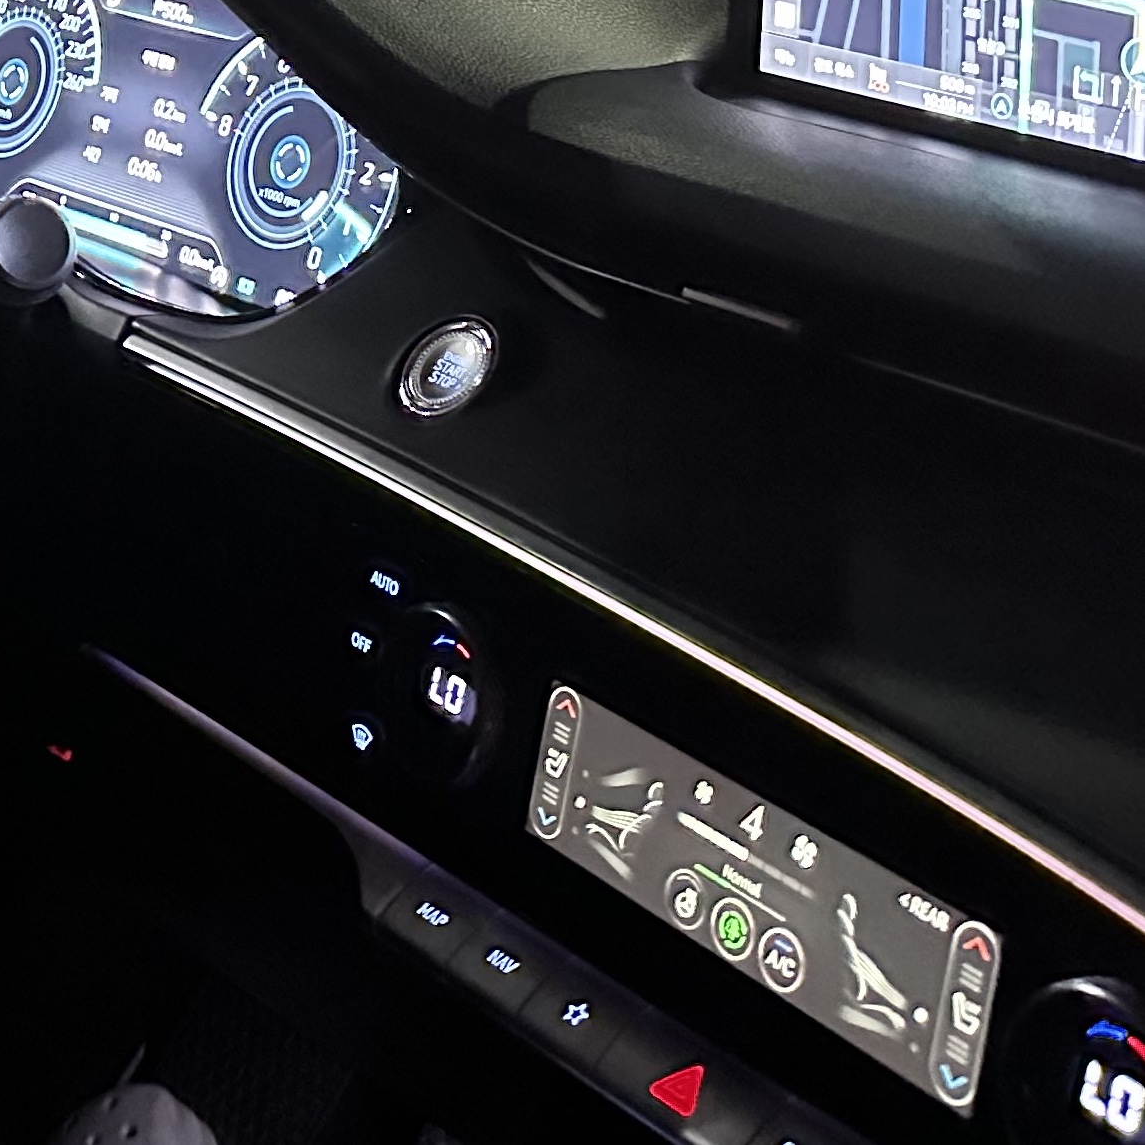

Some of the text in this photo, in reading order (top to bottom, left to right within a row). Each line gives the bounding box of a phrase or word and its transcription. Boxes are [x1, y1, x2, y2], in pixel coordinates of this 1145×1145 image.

[59, 13, 81, 32] 200
[65, 40, 88, 59] 230
[63, 73, 84, 92] 260
[245, 74, 259, 96] 7
[218, 113, 233, 136] 8
[358, 162, 377, 186] 2
[307, 246, 322, 270] 0
[370, 570, 400, 596] AUTO
[351, 631, 372, 653] OFF
[428, 666, 467, 716] LO
[738, 805, 765, 841] 4
[722, 863, 763, 899] Normal
[416, 902, 450, 926] MAP
[909, 895, 950, 933] REAR
[486, 949, 521, 974] NAV
[764, 949, 797, 979] A/C
[1079, 1059, 1145, 1133] LO
